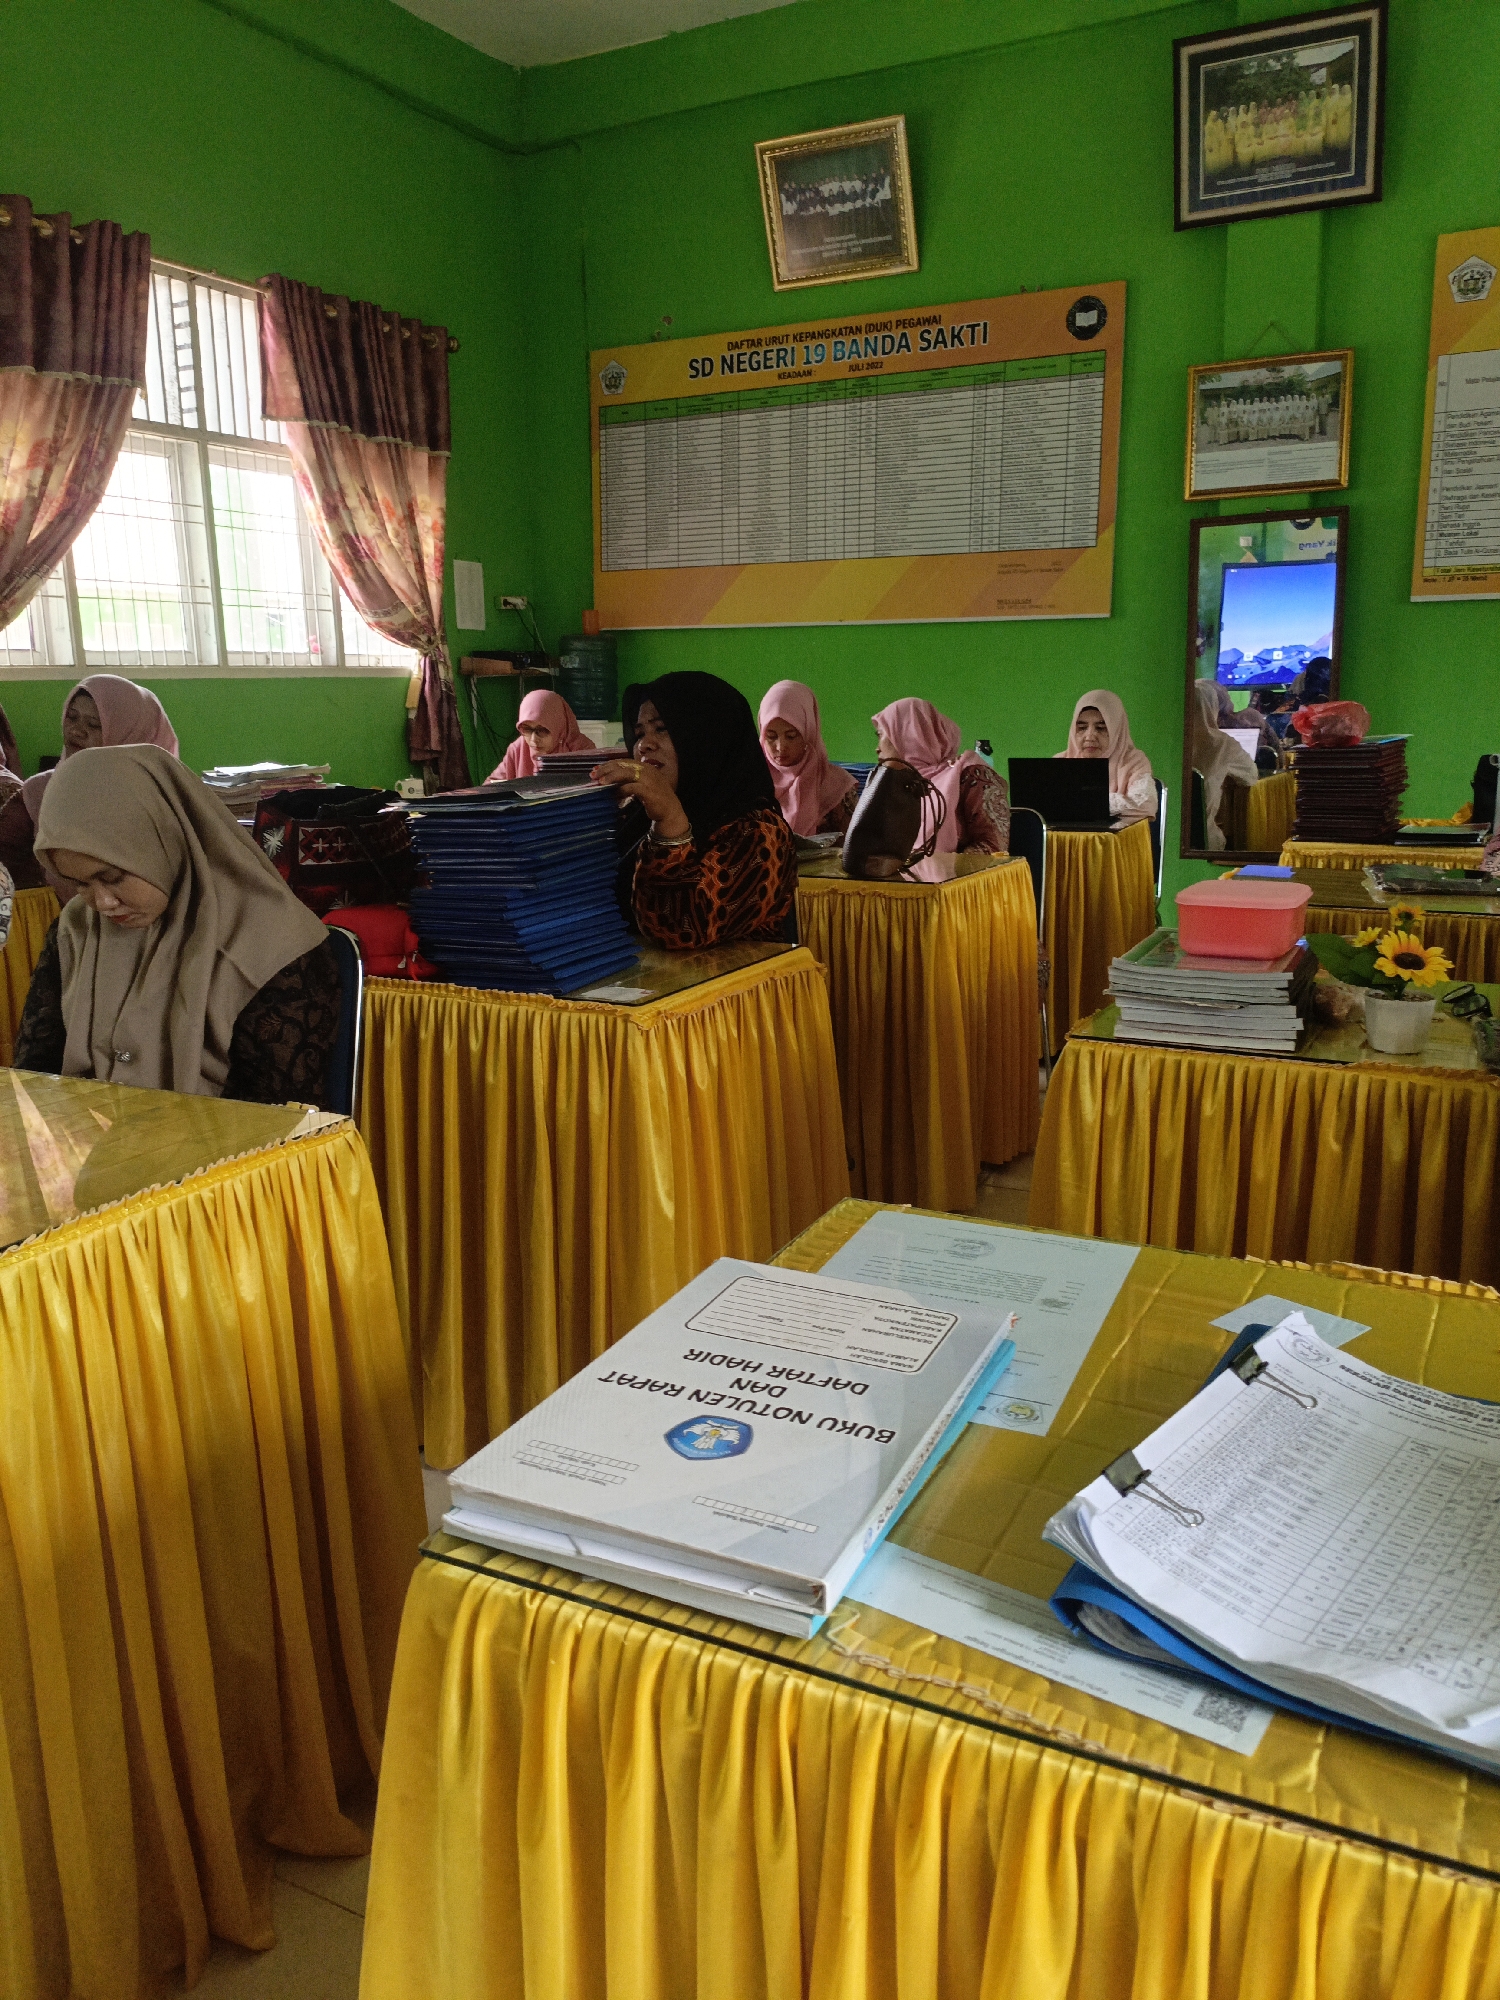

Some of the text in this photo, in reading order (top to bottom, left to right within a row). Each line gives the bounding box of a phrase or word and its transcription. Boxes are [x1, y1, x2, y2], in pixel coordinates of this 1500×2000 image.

[727, 315, 942, 351] DAFTAR URUT KEPANGKATAN (DUK) PEGAWAI
[688, 321, 990, 380] SD NEGERI 19 BANDA SAKTI
[848, 362, 864, 373] JULI
[777, 369, 812, 381] KEADAAN
[879, 1305, 923, 1315] PELAJARAN
[911, 1318, 946, 1326] PROVINSI
[890, 1327, 937, 1338] KECAMATAN
[847, 1346, 918, 1362] ALAMAT SEKOLAH
[851, 1354, 888, 1363] SEKOLAH
[683, 1349, 869, 1396] DAFTAR HADIR
[729, 1377, 788, 1398] DAN
[598, 1371, 896, 1444] BUKU NOTULEN RAPAT
